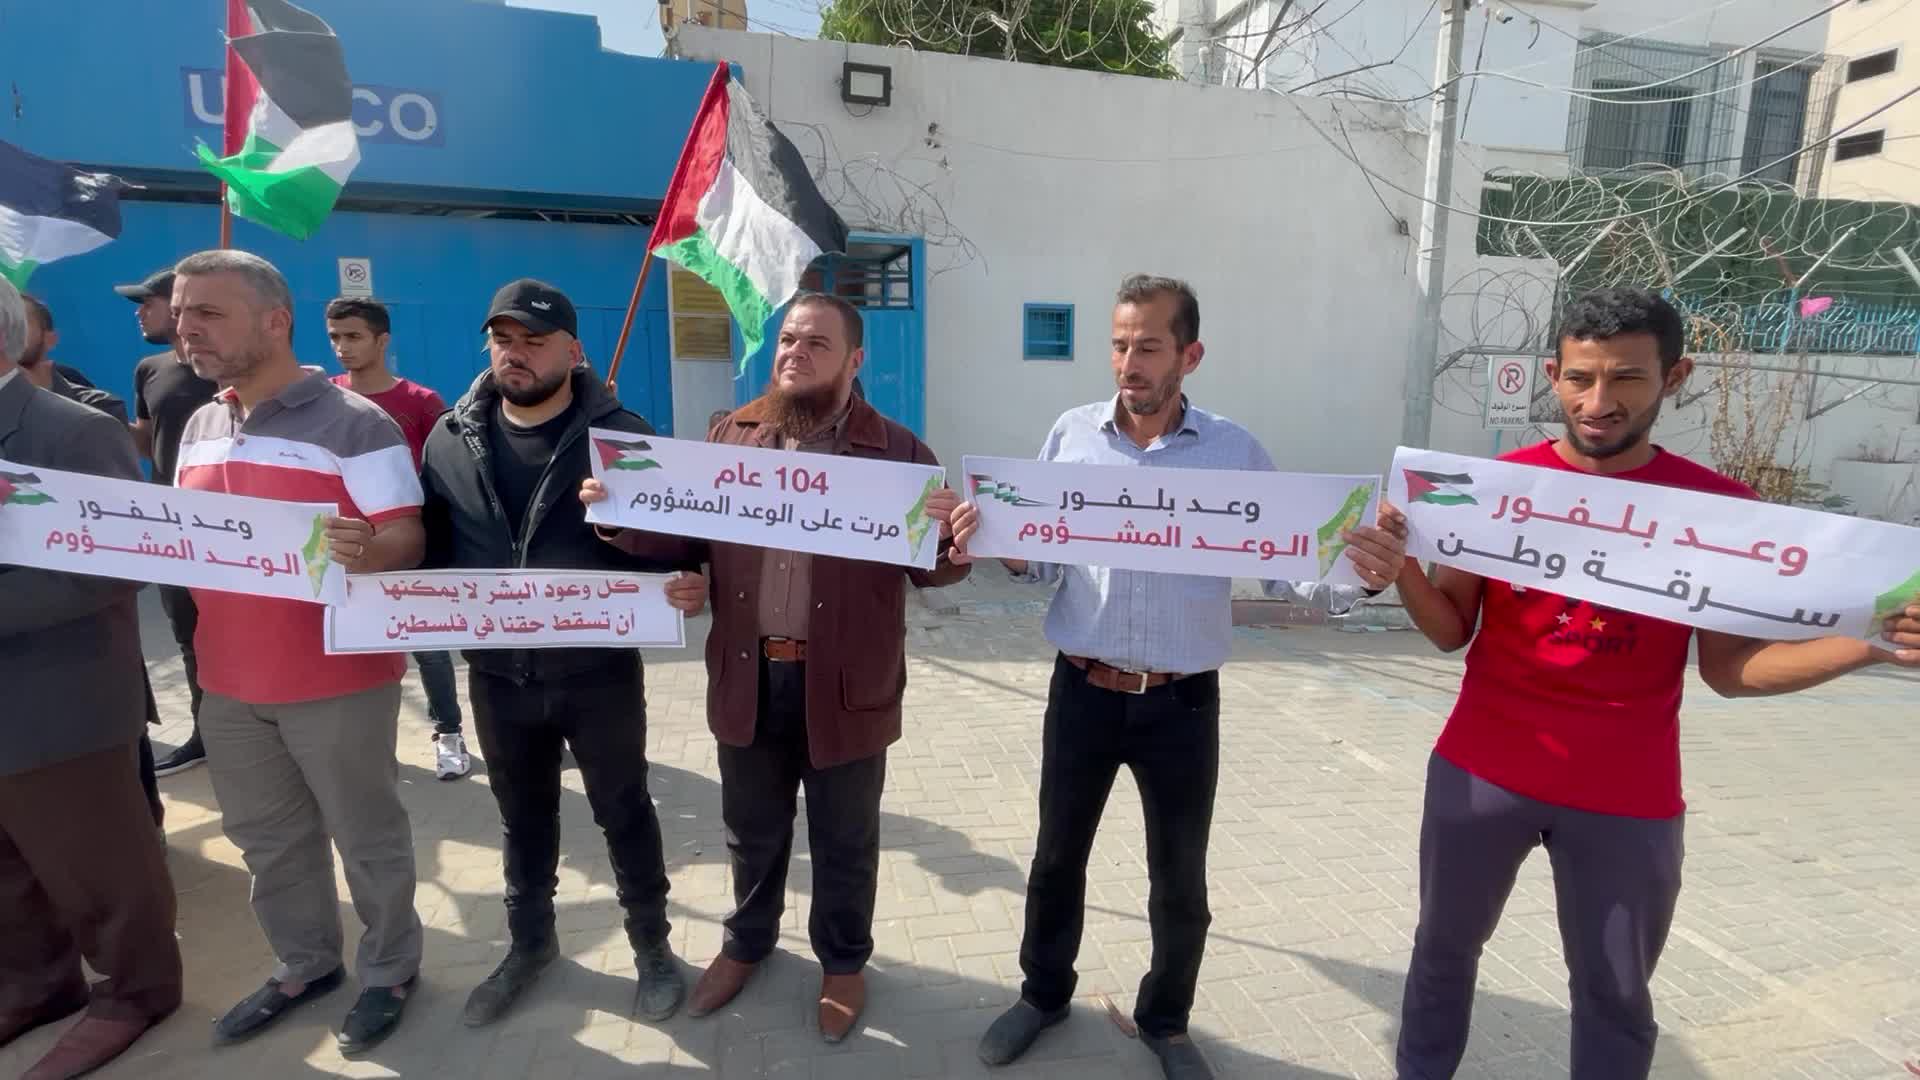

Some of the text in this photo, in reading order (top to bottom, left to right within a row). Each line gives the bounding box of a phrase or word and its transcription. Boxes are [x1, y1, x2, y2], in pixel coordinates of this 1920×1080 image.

[189, 73, 438, 140] UCO
[713, 462, 829, 495] 104 عام
[78, 499, 253, 539] وعد بلفور
[630, 488, 901, 541] مرت على الوعد المشؤوم
[1058, 487, 1261, 523] وعد بلفور
[46, 525, 300, 577] الوعد المشؤوم
[1017, 515, 1309, 562] الوعد المشؤوم
[1490, 490, 1810, 577] وعد بلفور
[379, 579, 460, 603] يمكنها
[488, 580, 537, 605] البشر
[544, 582, 592, 601] وعود
[597, 578, 641, 599] كل
[1436, 531, 1842, 629] سرقة وطن
[386, 608, 636, 641] أن تسقط حقنا في فلسطين
